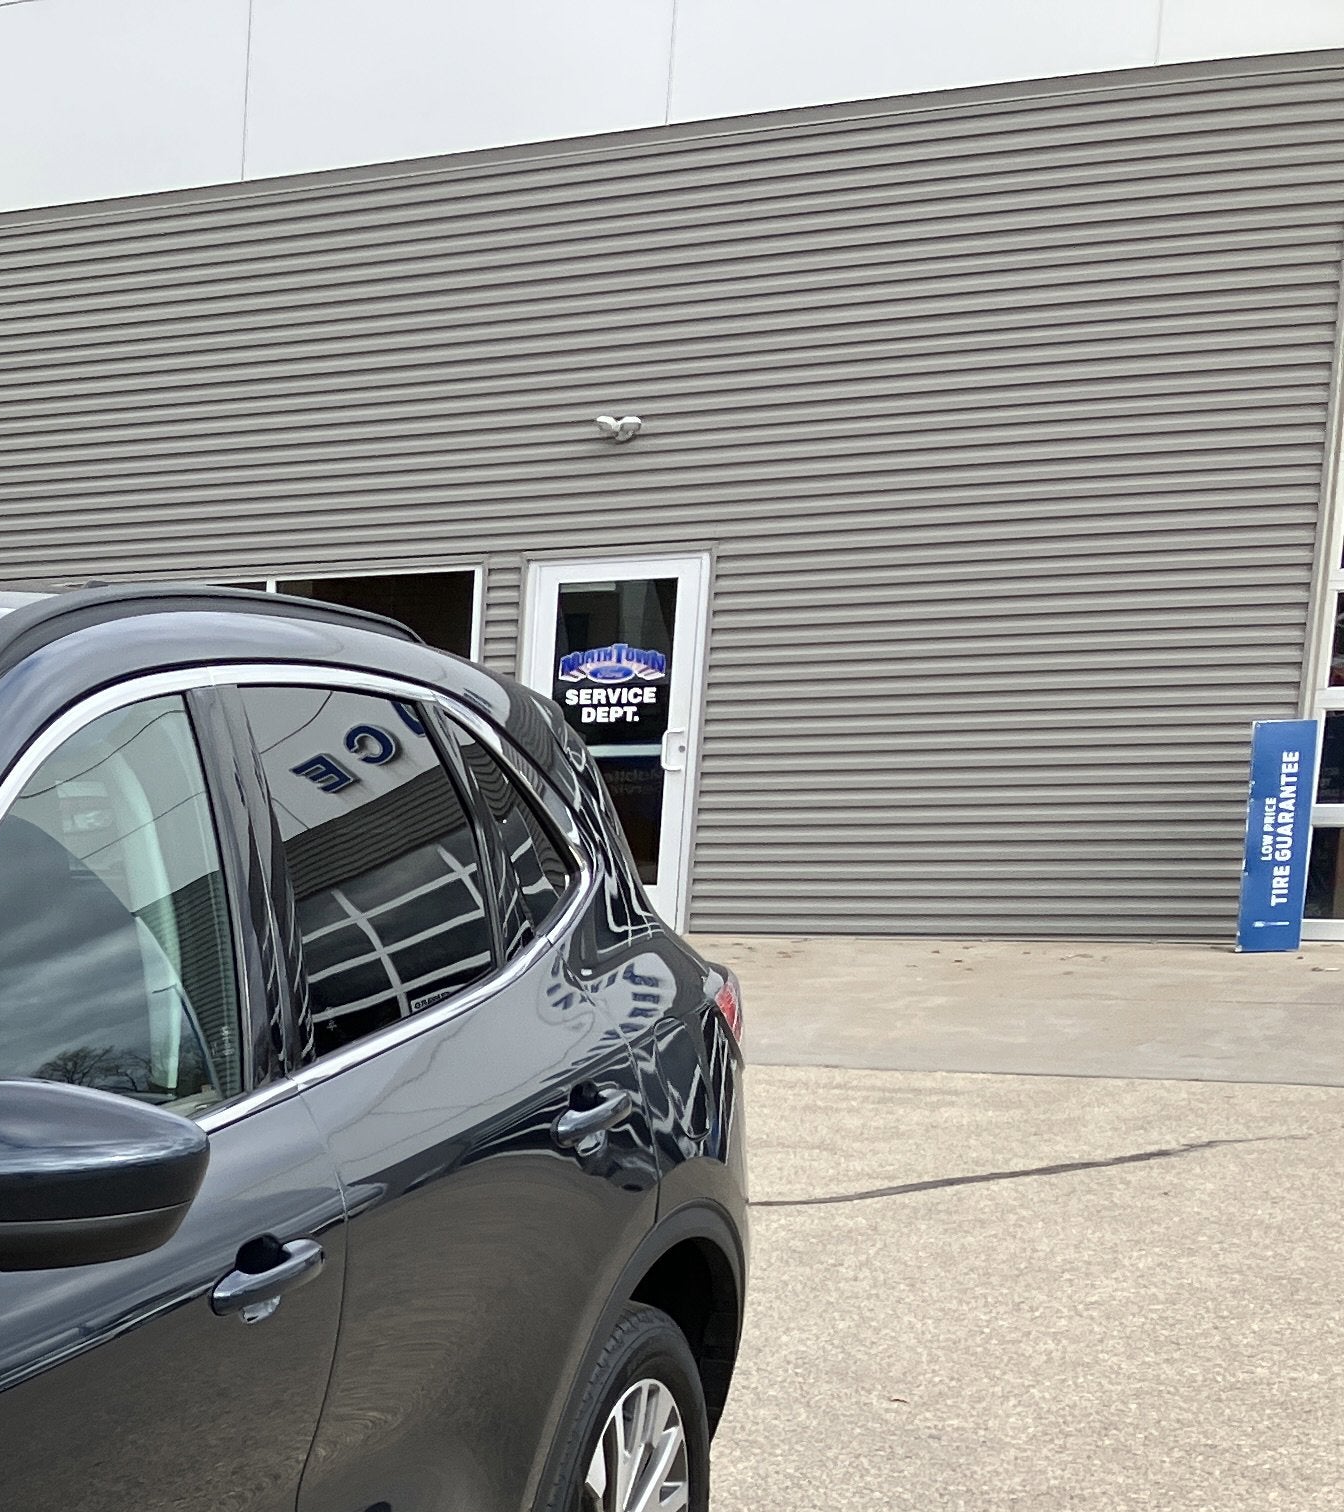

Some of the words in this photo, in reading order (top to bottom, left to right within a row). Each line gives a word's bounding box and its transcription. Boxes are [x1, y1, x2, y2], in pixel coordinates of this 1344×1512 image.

[564, 687, 657, 705] SERVICE
[581, 706, 640, 723] DEPT.
[1263, 797, 1277, 831] PRICE
[1274, 751, 1300, 862] GUARANTEE
[1261, 835, 1274, 861] LOW
[1270, 865, 1291, 907] TIRE
